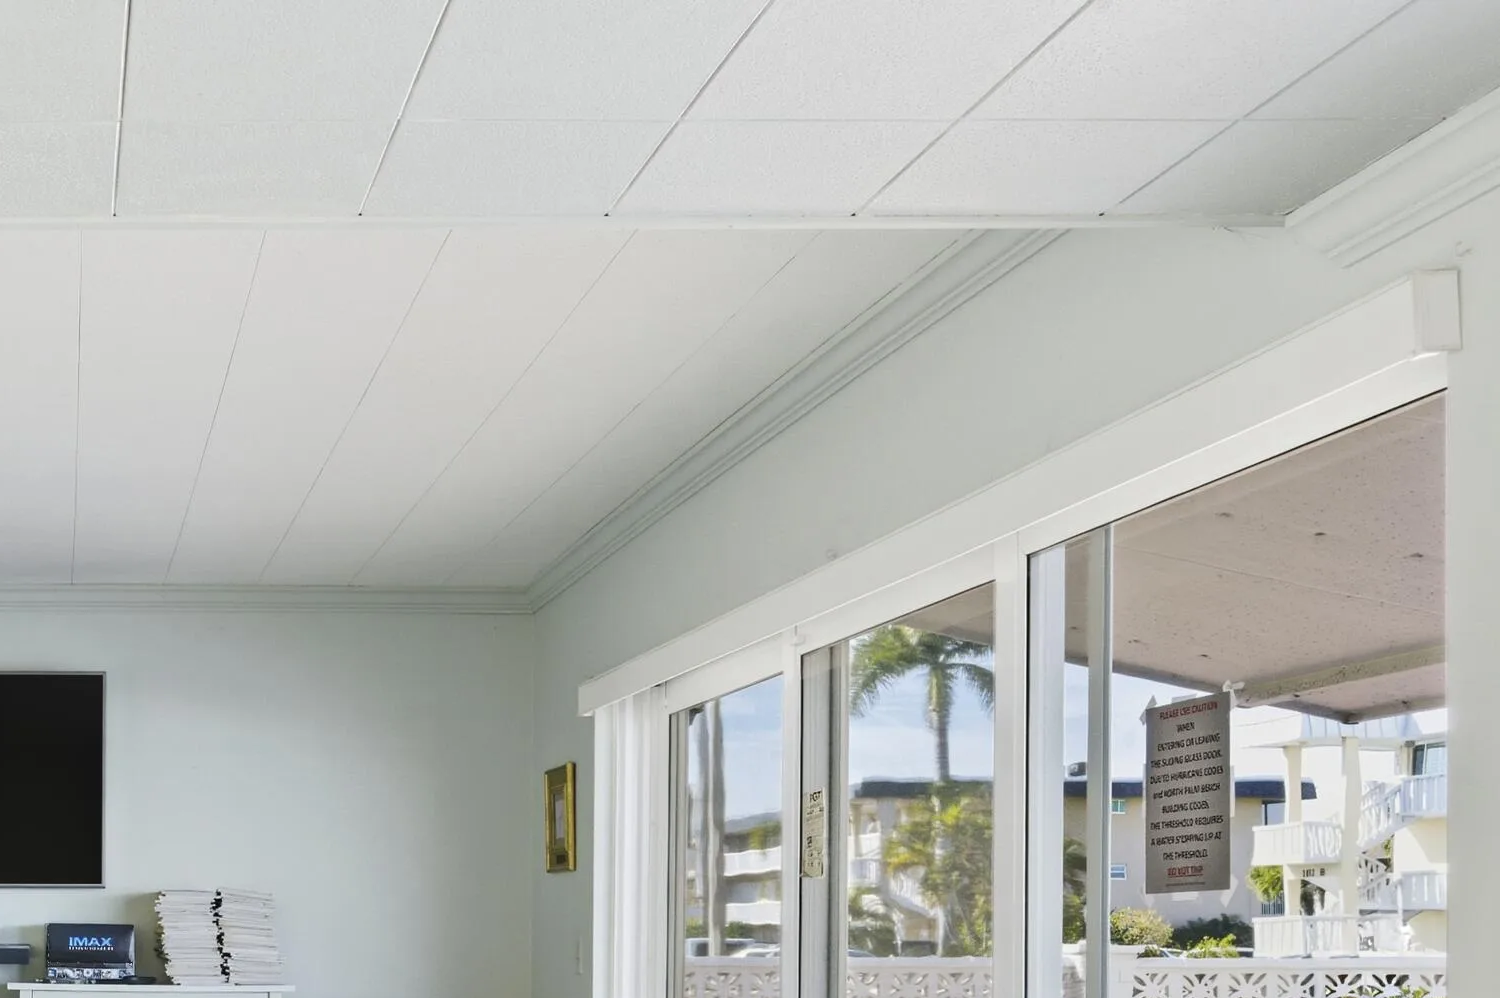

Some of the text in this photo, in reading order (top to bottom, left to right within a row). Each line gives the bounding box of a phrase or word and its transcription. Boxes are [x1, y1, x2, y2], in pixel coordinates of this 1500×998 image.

[1160, 708, 1178, 720] PLEASE
[1192, 701, 1218, 714] CAUTION
[1176, 722, 1195, 733] WHEN
[1158, 732, 1220, 752] ENTERING OR LEAVING
[1151, 760, 1161, 768] THE
[1162, 755, 1184, 767] SLIDING
[1184, 752, 1202, 763] GLASS
[1150, 776, 1162, 784] DUE
[1162, 774, 1169, 783] TO
[1170, 768, 1202, 781] HURRICANE
[1164, 788, 1183, 798] NORTH
[1184, 785, 1199, 794] PALM
[1201, 783, 1220, 793] BEACH
[1162, 802, 1188, 814] BUILDING
[1150, 815, 1224, 830] THE THRESHOLD REQUIRES
[1163, 852, 1174, 860] THE
[1178, 867, 1189, 875] NOT
[68, 937, 111, 946] IMAX
